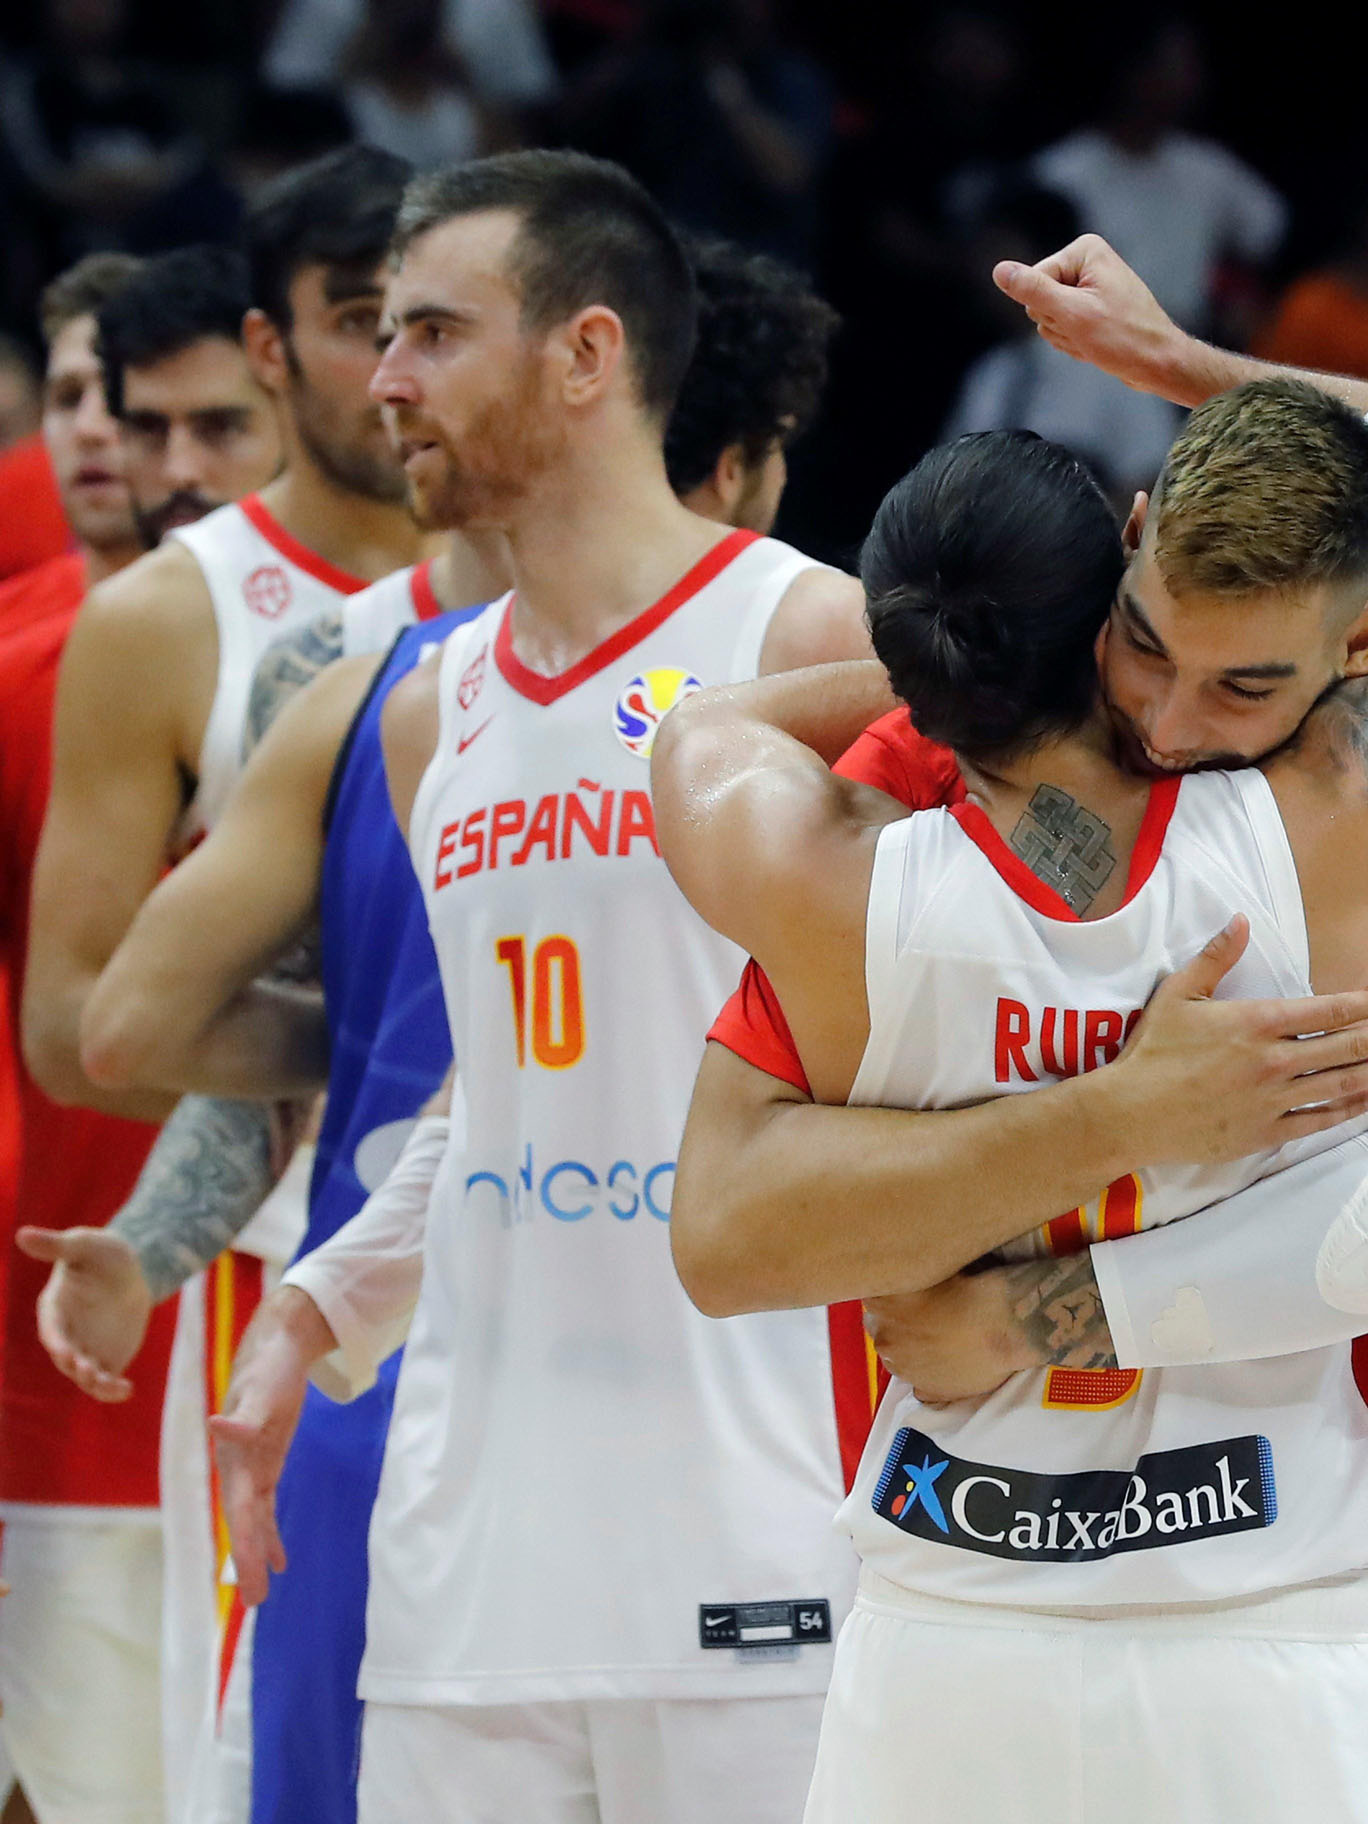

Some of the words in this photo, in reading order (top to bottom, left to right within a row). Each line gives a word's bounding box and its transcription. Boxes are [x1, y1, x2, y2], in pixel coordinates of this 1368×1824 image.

[434, 777, 662, 892] ESPAÑA
[494, 933, 585, 1071] 10
[994, 997, 1143, 1082] RUB
[950, 1456, 1258, 1551] CaixaBank
[799, 1611, 823, 1631] 54
